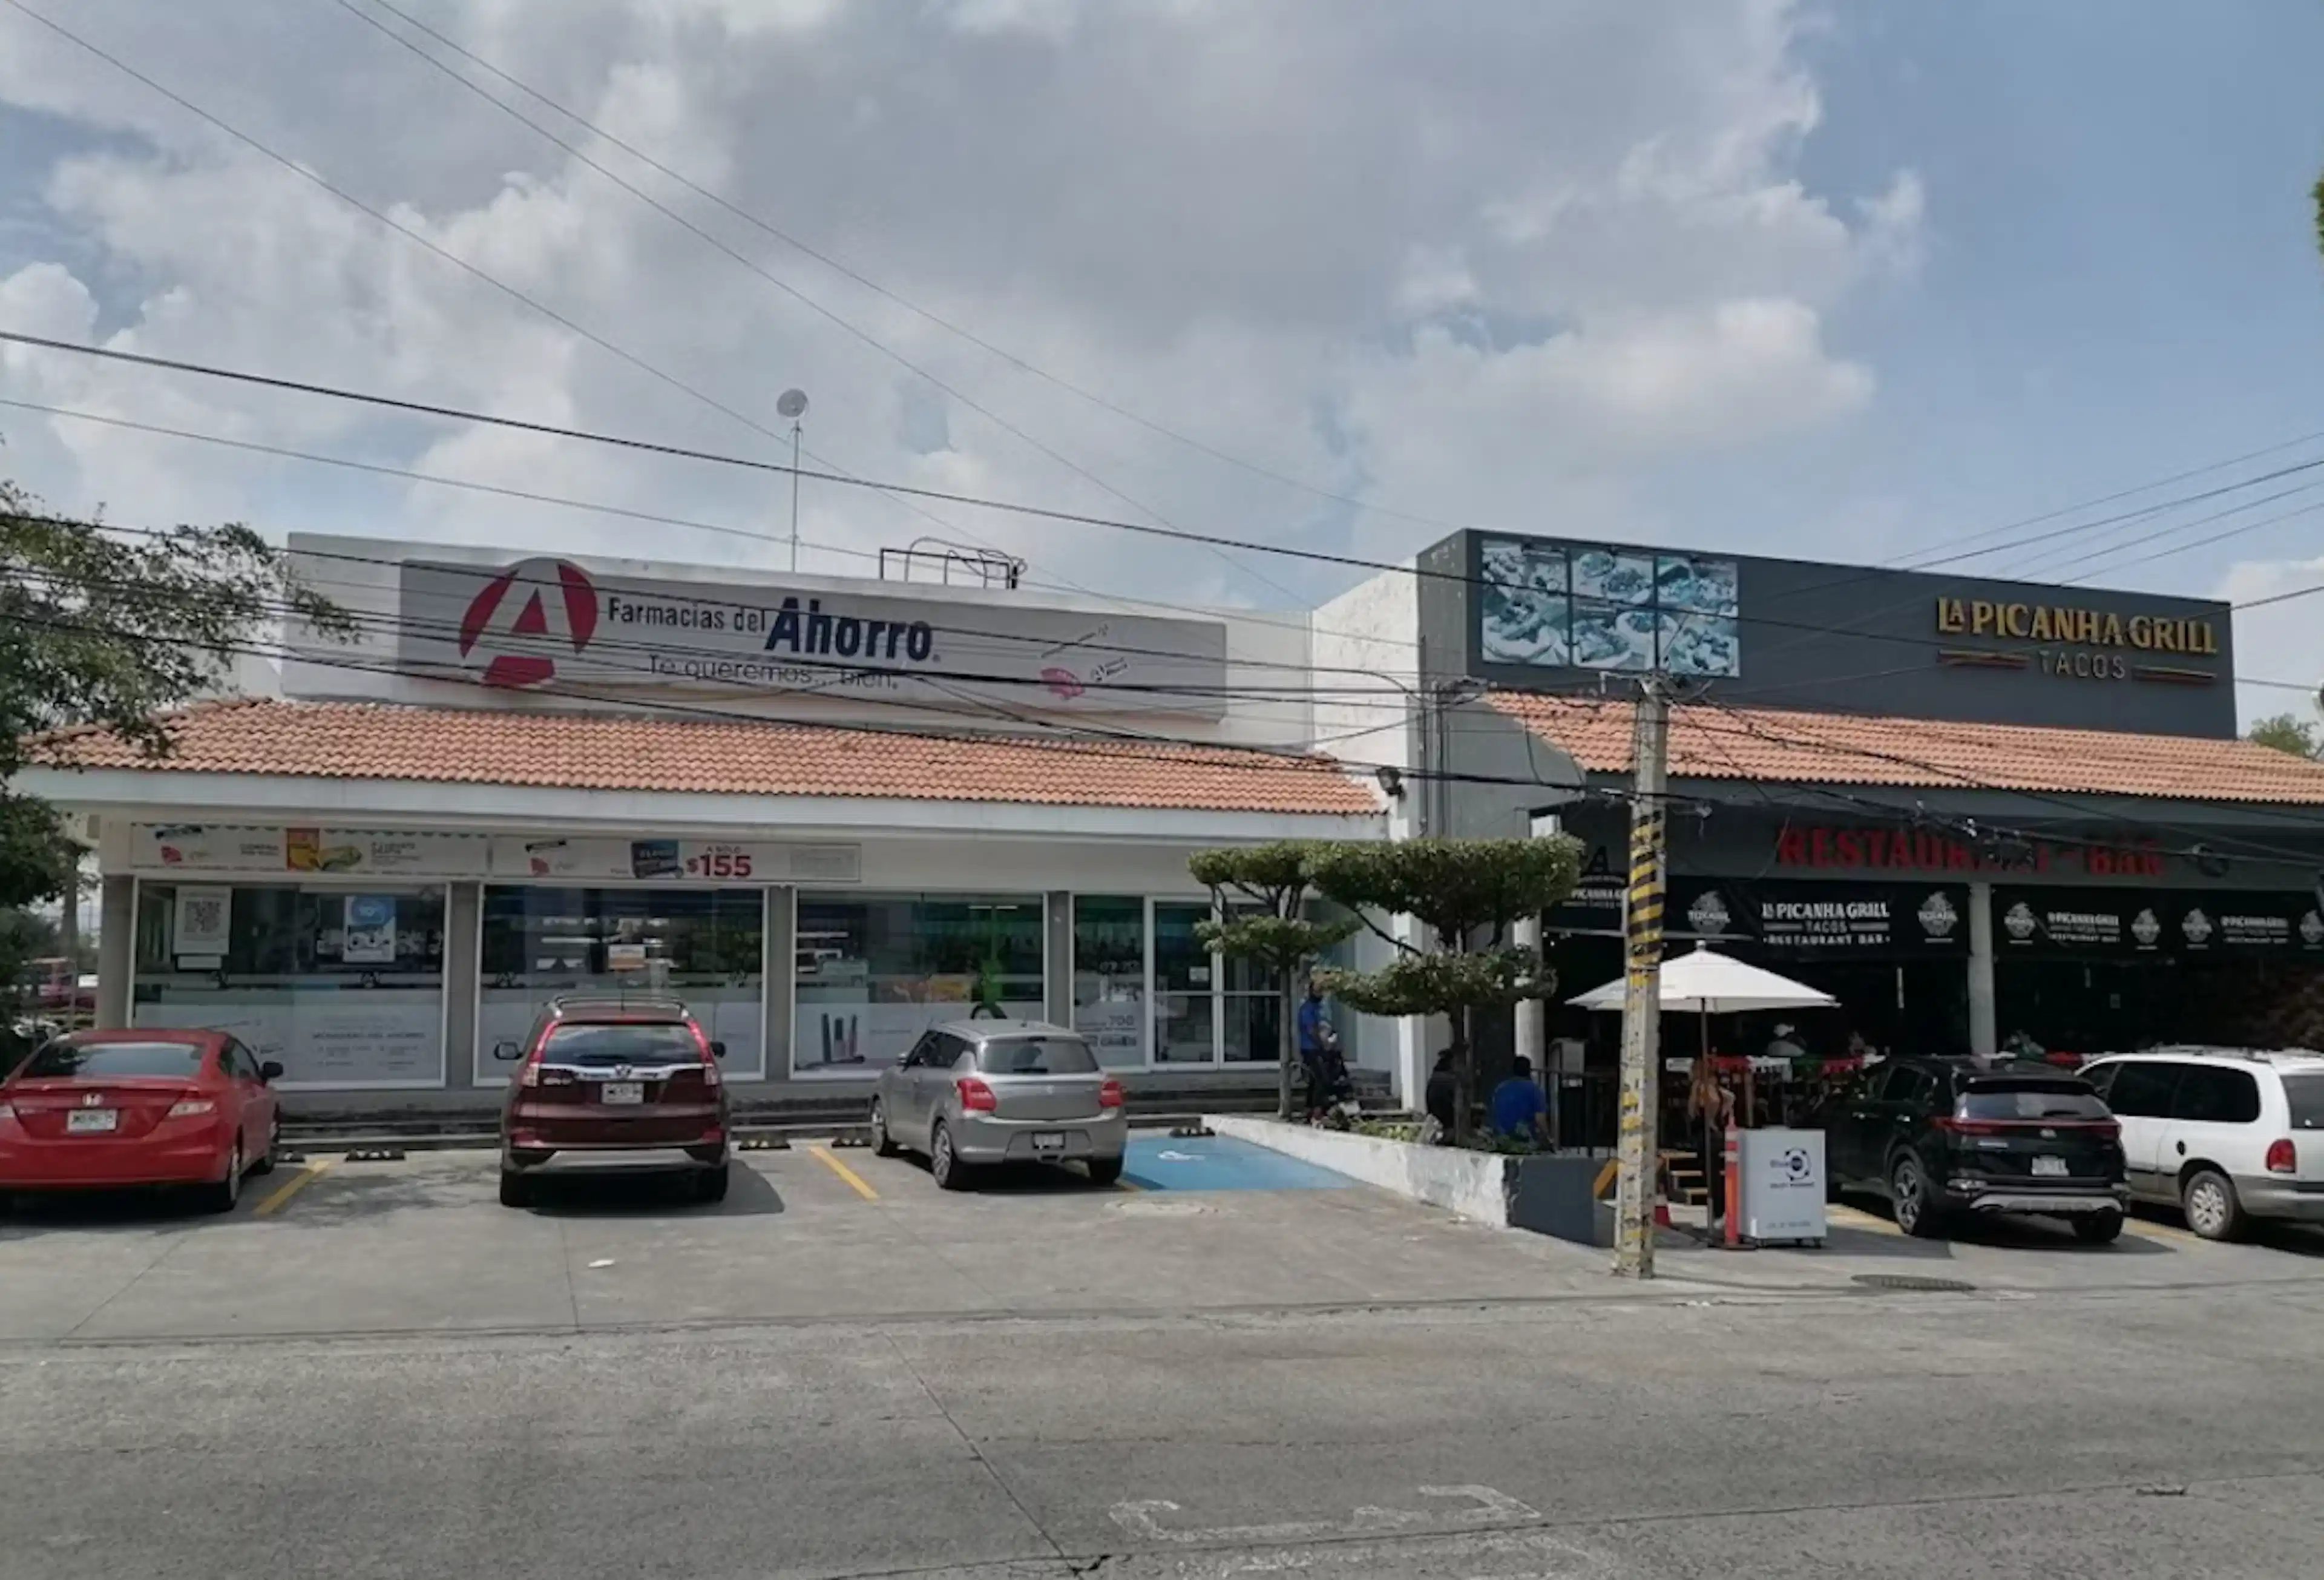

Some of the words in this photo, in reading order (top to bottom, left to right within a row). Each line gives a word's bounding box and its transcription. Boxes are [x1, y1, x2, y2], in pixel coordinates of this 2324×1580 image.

[608, 596, 724, 630] Farmacias
[734, 607, 766, 631] del
[764, 596, 931, 661] Ahorro
[1938, 596, 1966, 633] LA
[1971, 600, 2124, 647] PICANHA
[2129, 615, 2218, 654] GRILL
[2038, 650, 2126, 679] TACOS
[685, 854, 752, 877] $155
[1776, 902, 1845, 919] PICANHA
